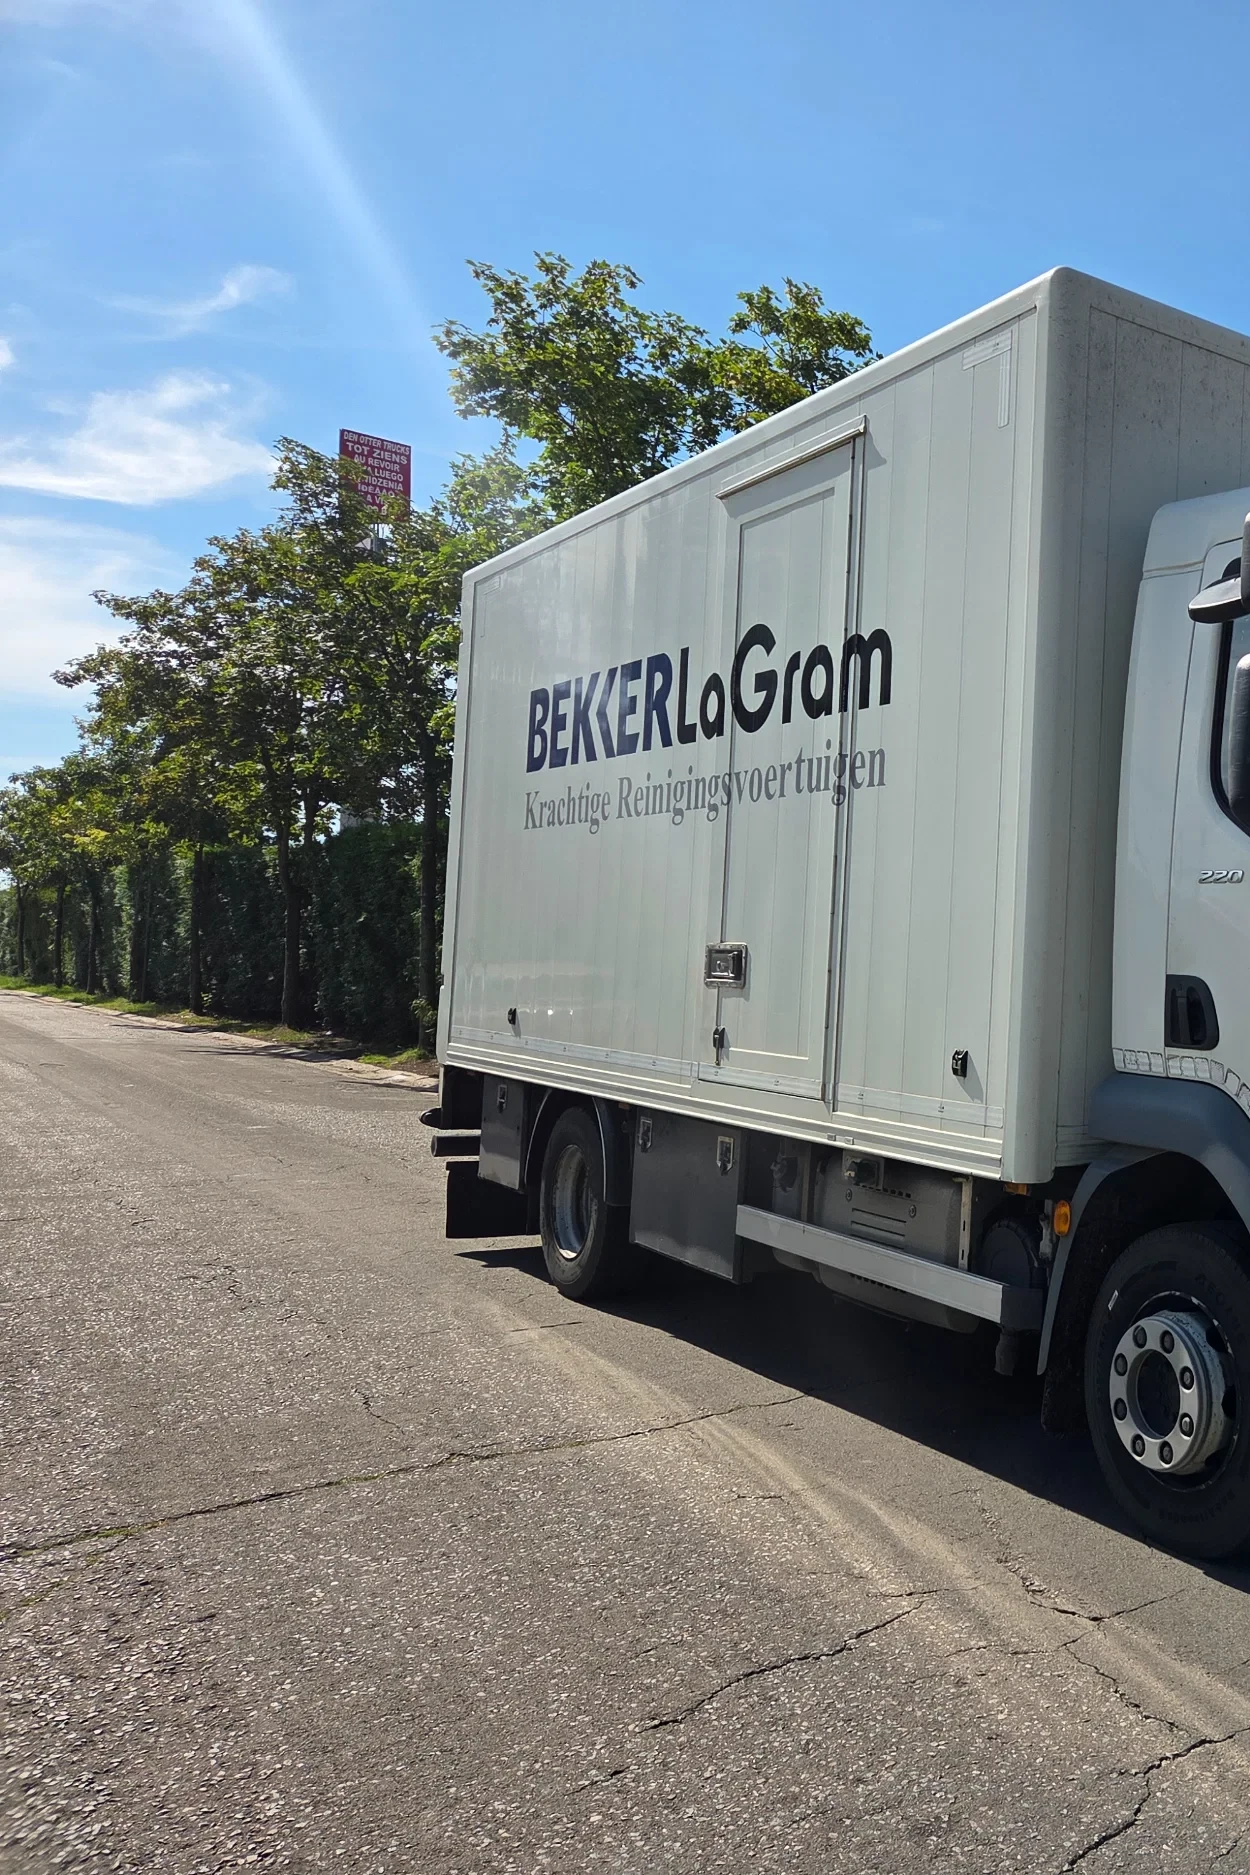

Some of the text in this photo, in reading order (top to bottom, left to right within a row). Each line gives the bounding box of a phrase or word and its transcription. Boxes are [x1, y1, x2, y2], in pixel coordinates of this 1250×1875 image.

[344, 431, 409, 455] DEN OTTER TRUCKS
[346, 442, 408, 465] TOT ZIENS
[354, 454, 366, 463] AU
[368, 457, 400, 472] REVOIR
[374, 468, 404, 481] LUEGO
[524, 739, 886, 834] Krachtige Reinigingsvoertuigen
[1198, 869, 1244, 884] 220
